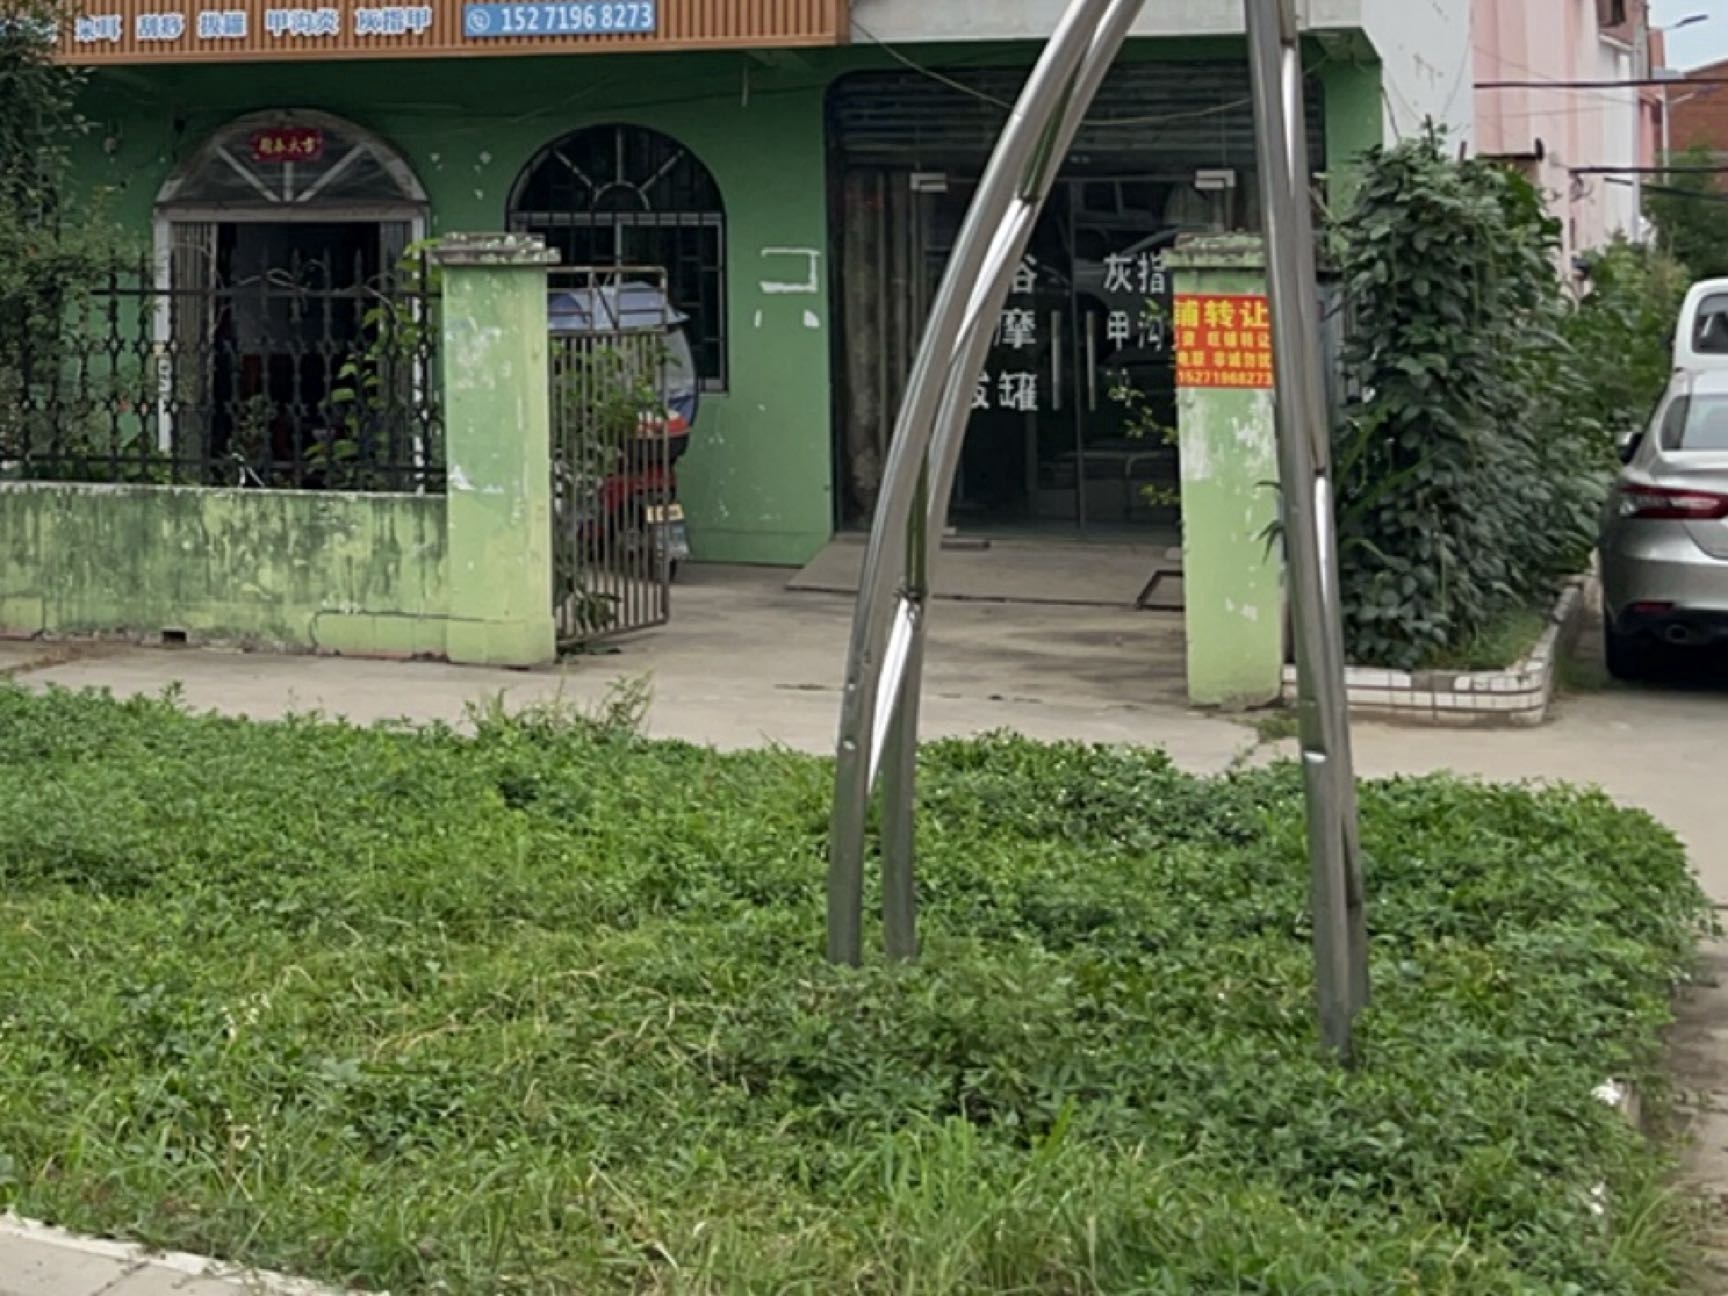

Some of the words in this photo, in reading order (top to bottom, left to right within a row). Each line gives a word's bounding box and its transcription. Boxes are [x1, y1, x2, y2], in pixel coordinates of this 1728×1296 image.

[501, 7, 540, 32] 152
[545, 6, 597, 31] 7196
[601, 4, 653, 30] 8273
